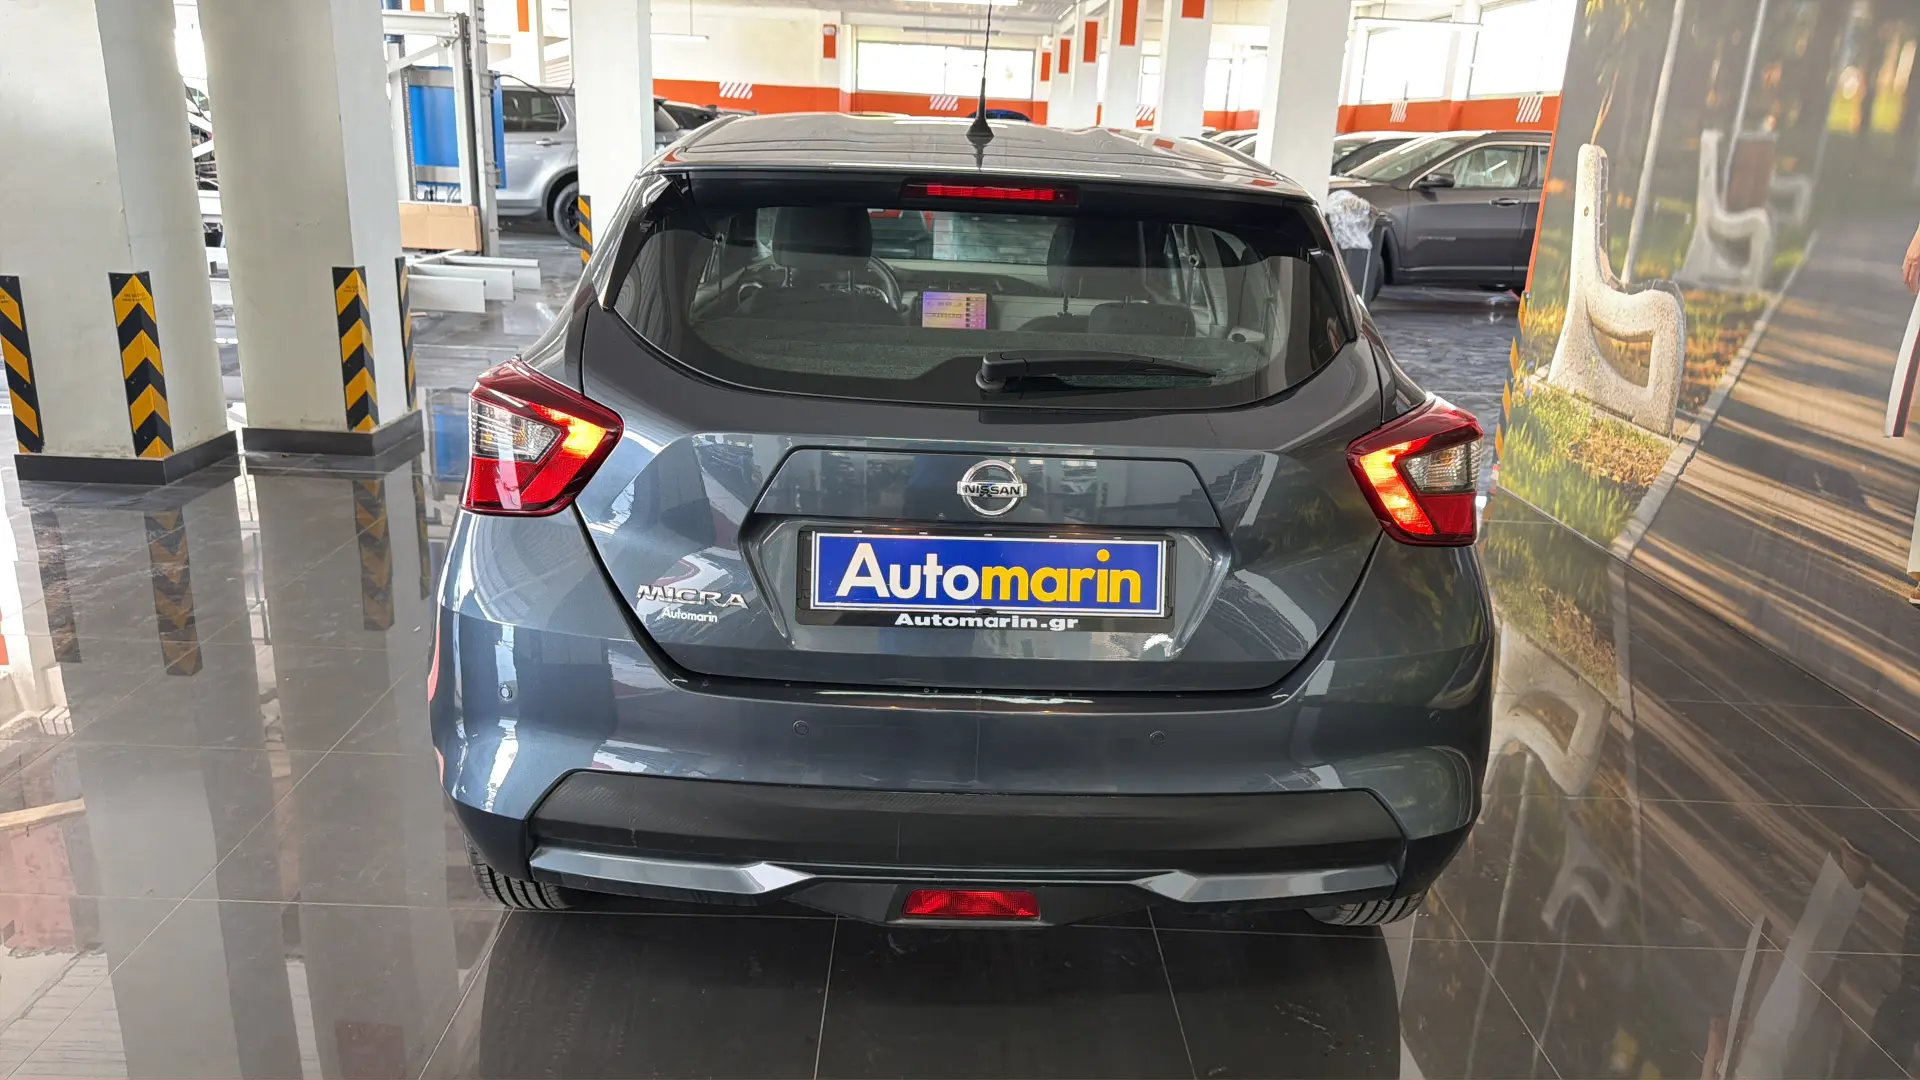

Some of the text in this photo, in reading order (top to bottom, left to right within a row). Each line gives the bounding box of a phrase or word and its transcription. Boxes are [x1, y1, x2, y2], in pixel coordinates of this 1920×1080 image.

[964, 484, 1021, 496] NISSAN
[836, 542, 1141, 604] Automarin
[636, 584, 749, 609] MICRA
[661, 607, 718, 624] Automarin
[894, 612, 1080, 632] Automarin.gr
